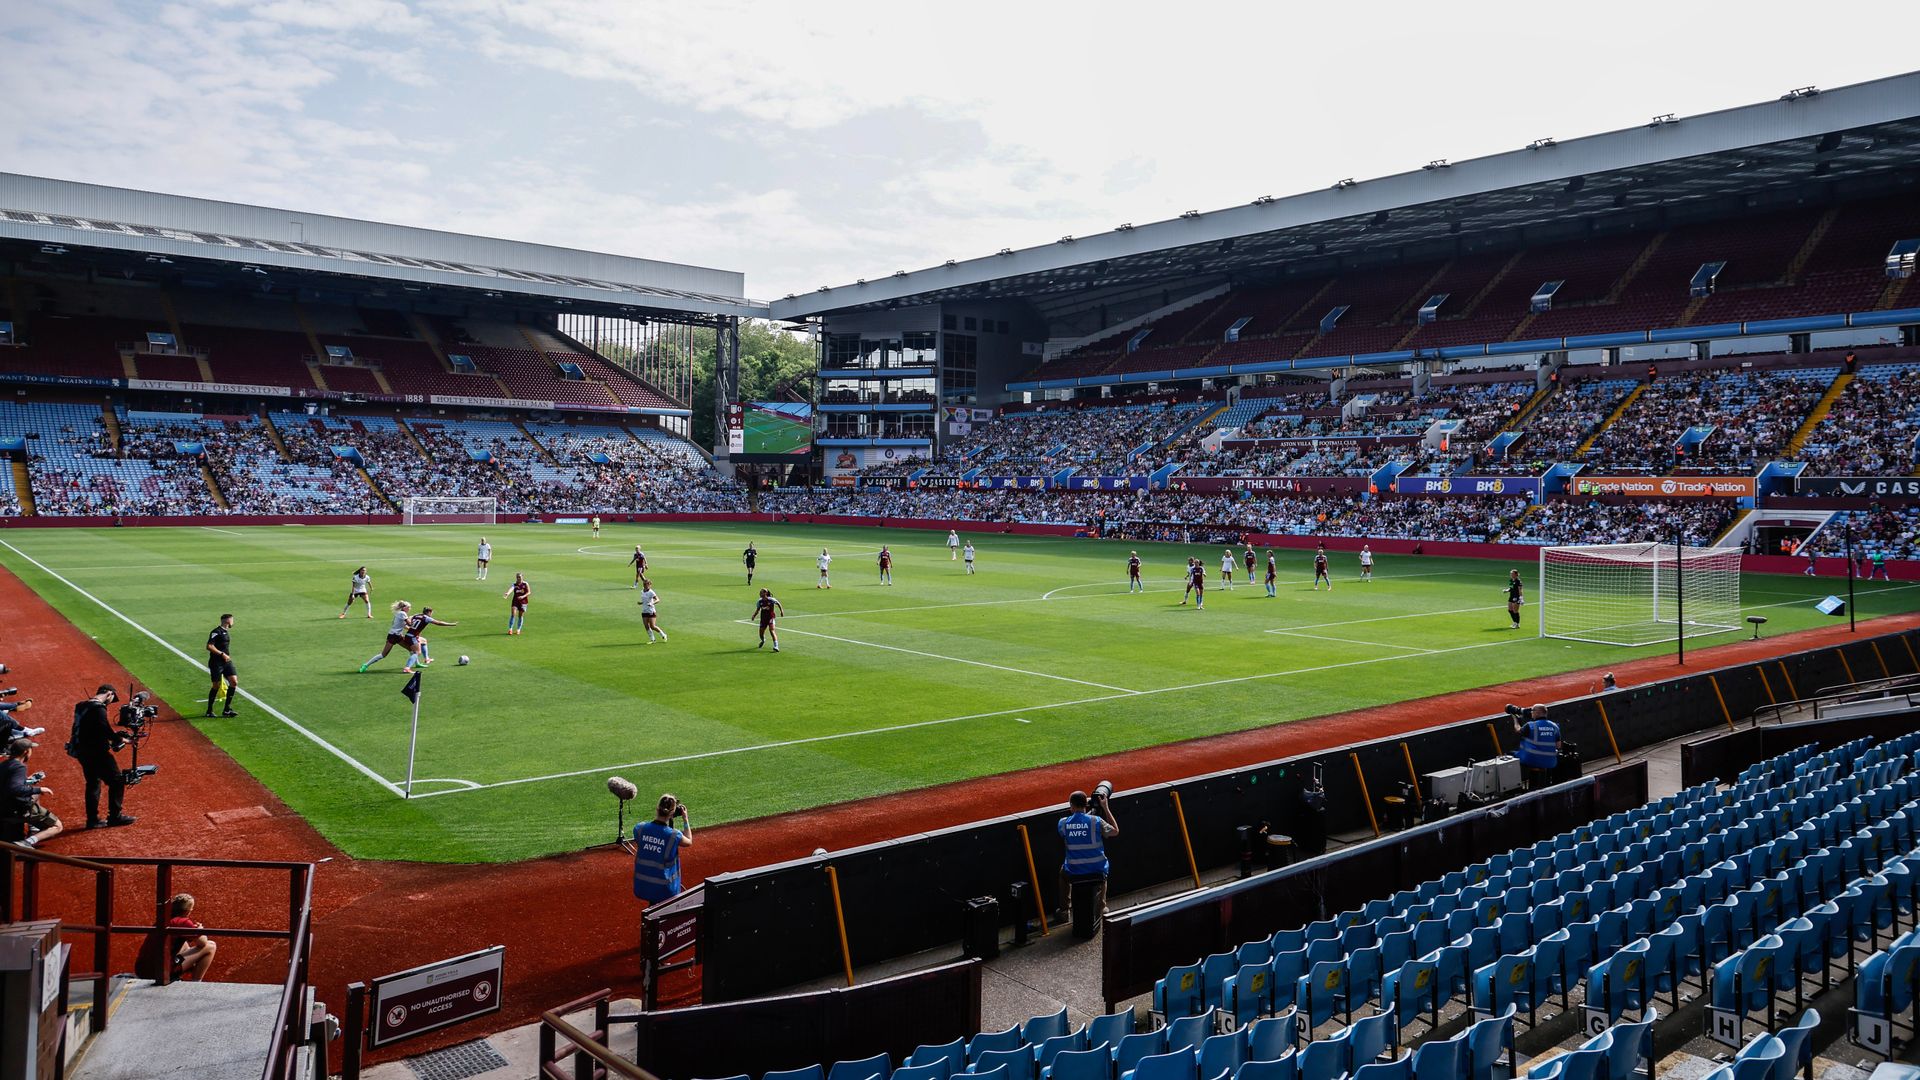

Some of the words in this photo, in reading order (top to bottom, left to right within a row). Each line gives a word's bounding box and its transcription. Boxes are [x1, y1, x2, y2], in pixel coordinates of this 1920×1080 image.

[57, 377, 93, 385] AGAINST
[141, 381, 173, 389] AVFC
[183, 382, 208, 391] THE
[212, 384, 280, 395] OBSESSION
[405, 394, 424, 403] 1888
[436, 396, 464, 404] HOLTE
[1232, 480, 1244, 489] UP
[1246, 480, 1264, 489] THE
[1265, 480, 1293, 489] VILLA
[1425, 479, 1451, 492] BK8
[1476, 479, 1504, 492] BK8
[1622, 482, 1654, 491] Nation
[642, 835, 665, 846] MEDIA
[643, 844, 662, 853] AVFC
[410, 1003, 421, 1011] NO
[421, 989, 471, 1008] UNAUTHORISED
[428, 1002, 453, 1015] ACCESS
[1156, 1017, 1162, 1031] B
[1225, 1017, 1232, 1032] C
[1298, 1017, 1306, 1033] D
[1590, 1016, 1605, 1033] G
[1718, 1016, 1734, 1040] H
[1867, 1024, 1882, 1045] J
